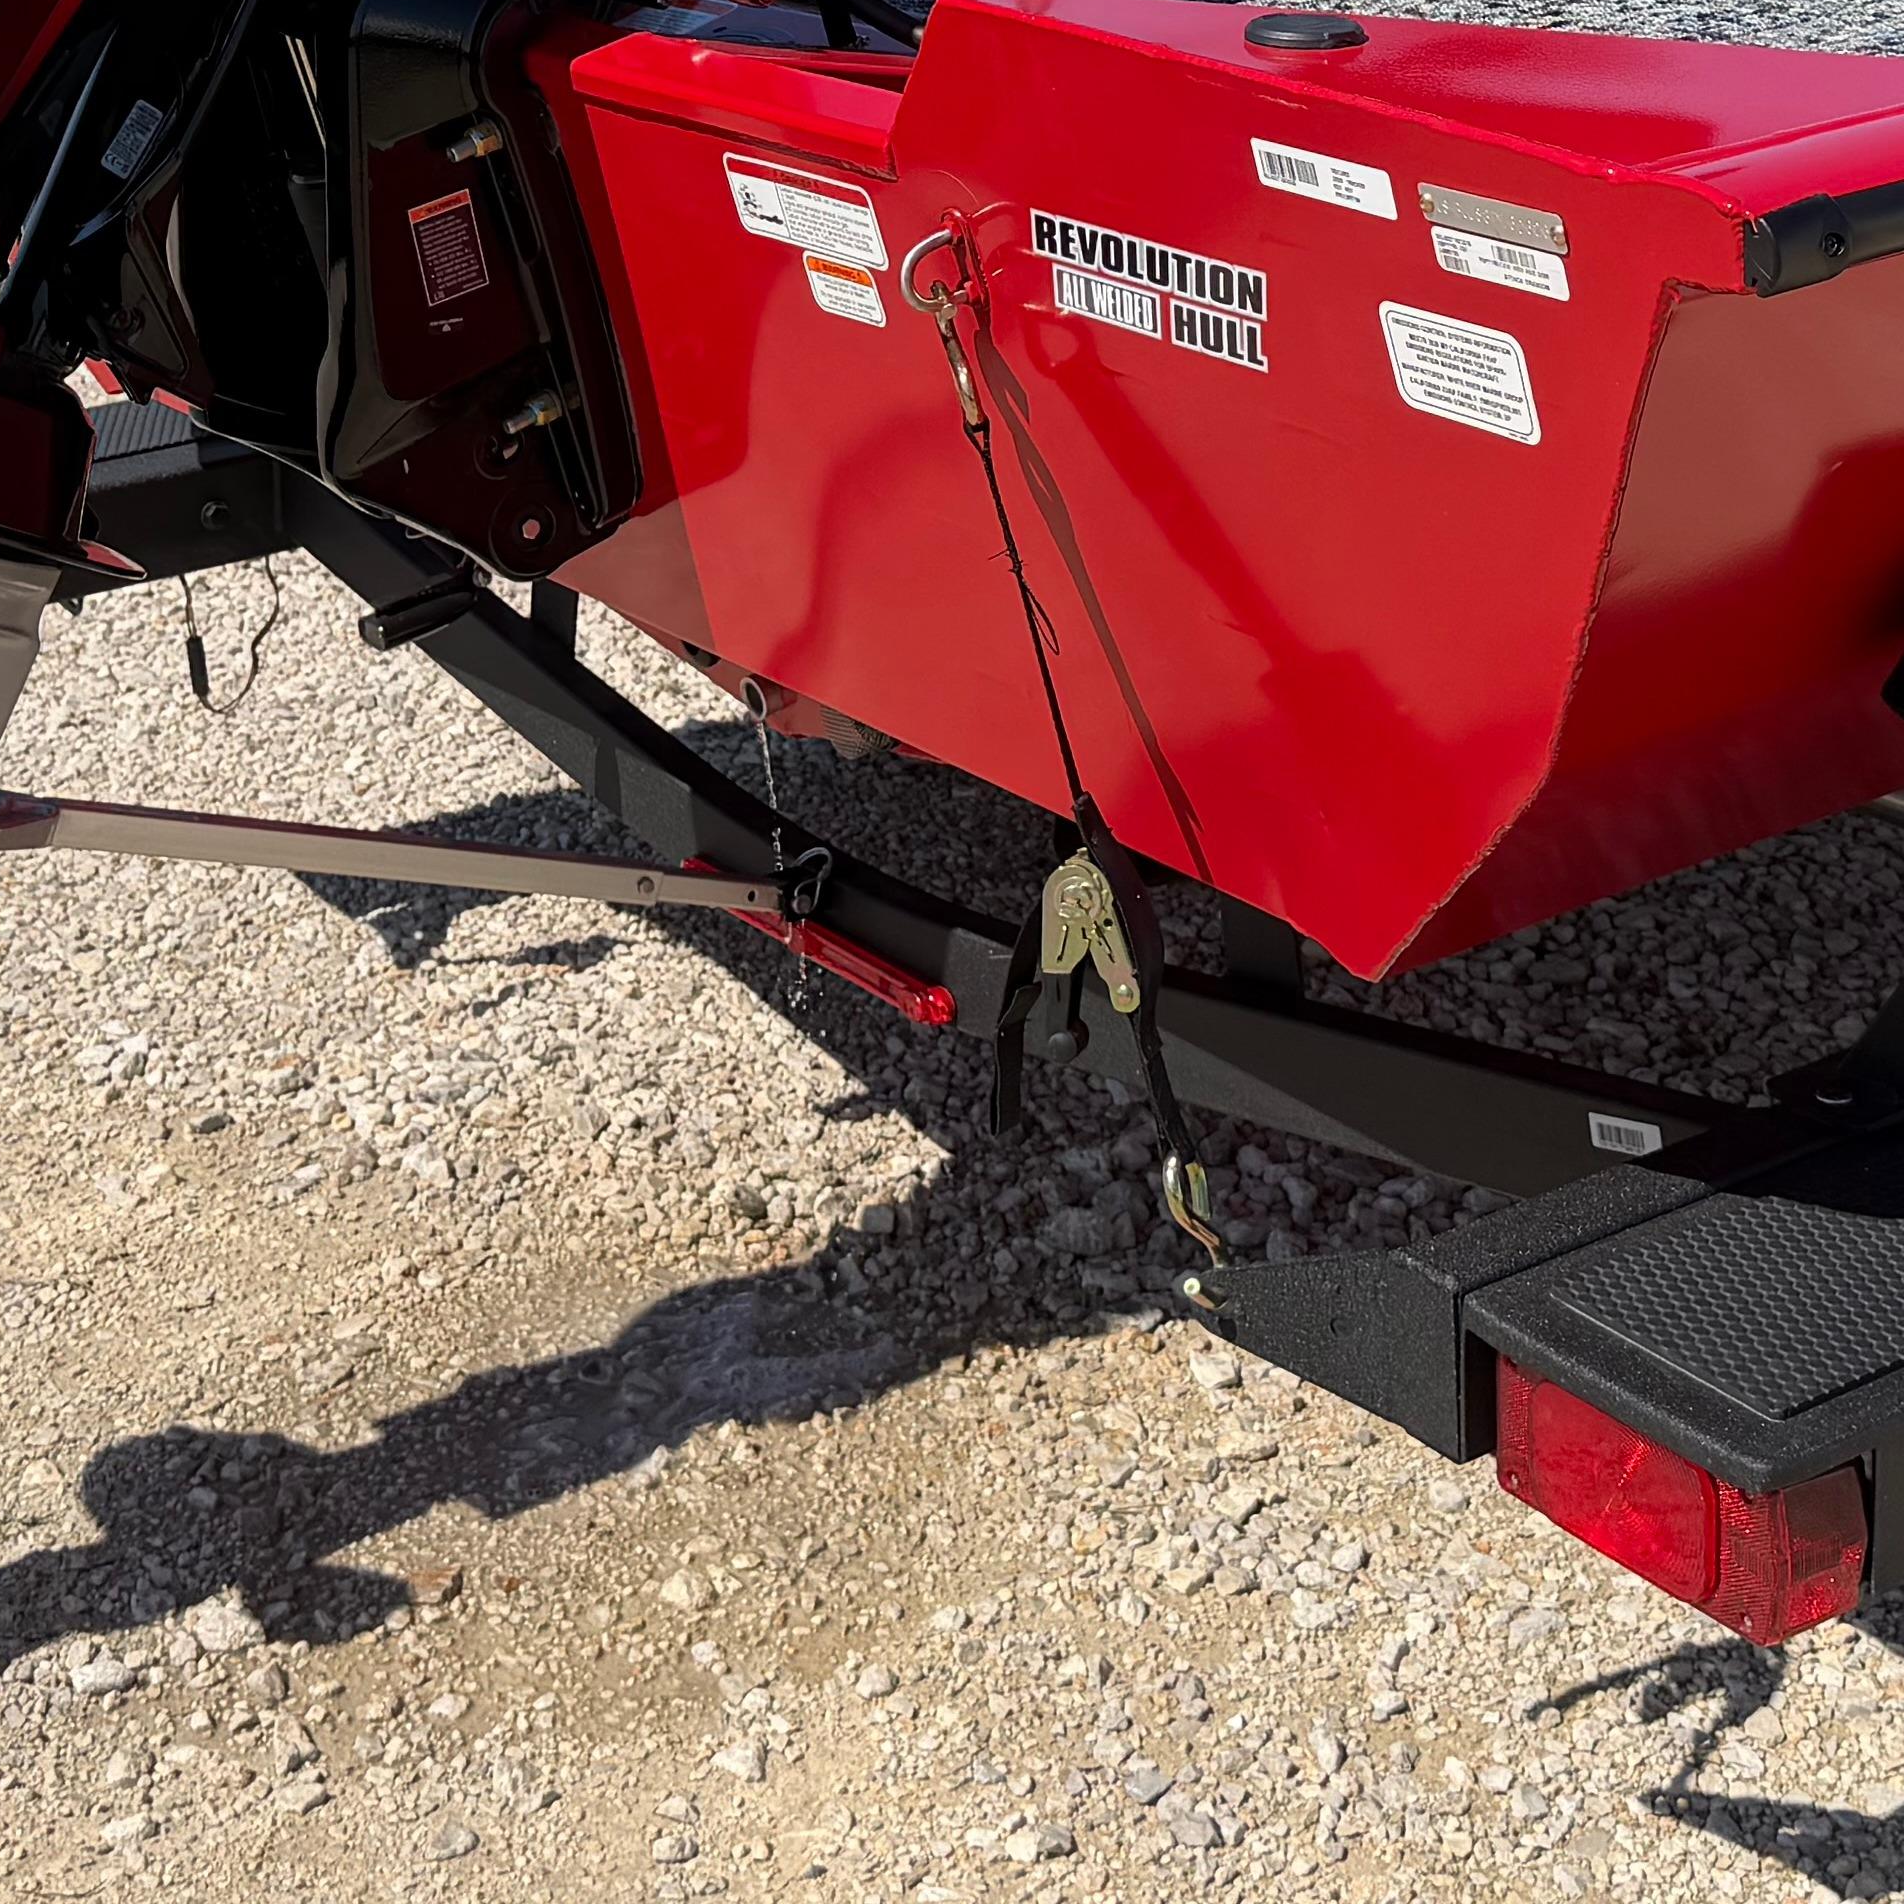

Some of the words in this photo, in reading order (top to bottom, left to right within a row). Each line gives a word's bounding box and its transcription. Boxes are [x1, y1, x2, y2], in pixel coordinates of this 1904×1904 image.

[1034, 213, 1264, 315] REVOLUTION
[1062, 272, 1089, 309] ALL
[1091, 281, 1155, 332] WELDED
[1173, 304, 1265, 367] HULL
